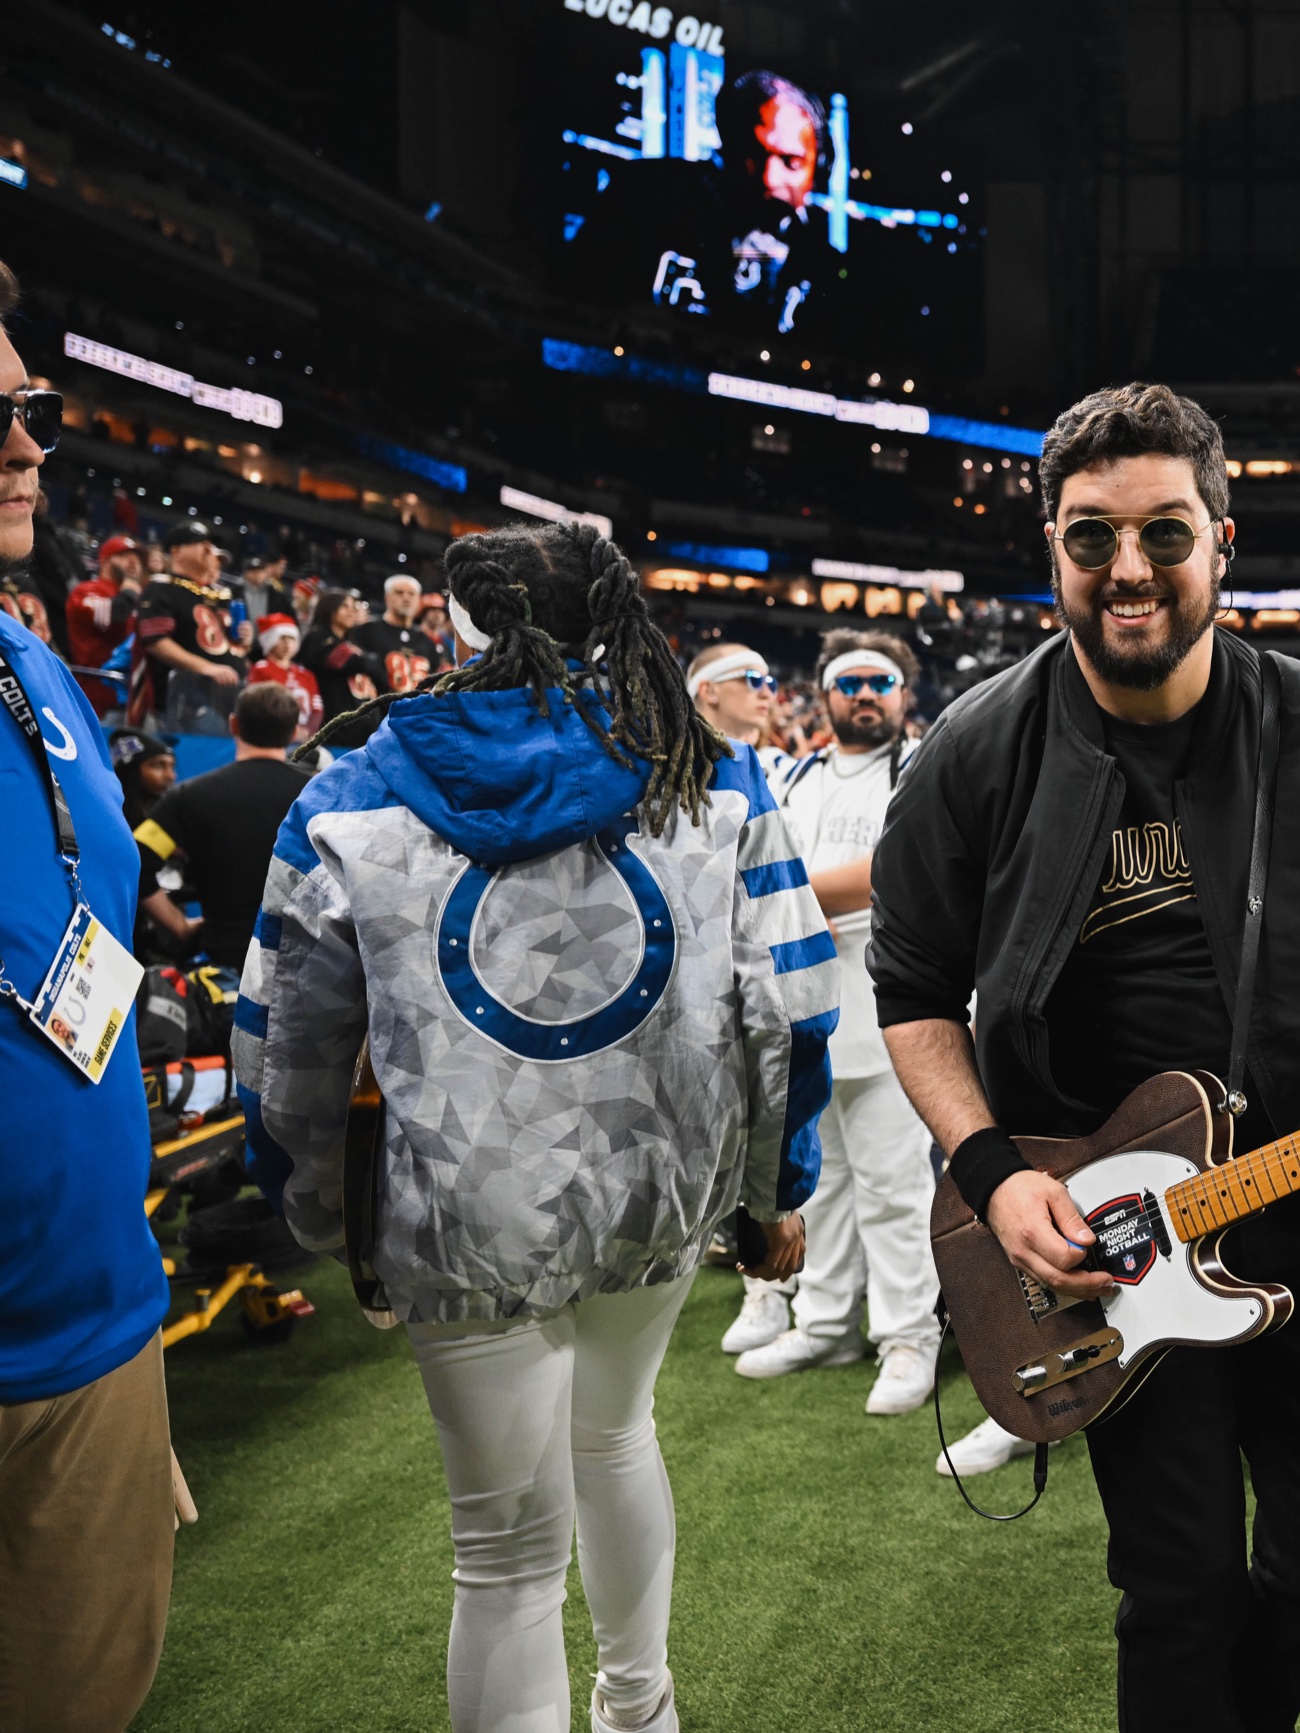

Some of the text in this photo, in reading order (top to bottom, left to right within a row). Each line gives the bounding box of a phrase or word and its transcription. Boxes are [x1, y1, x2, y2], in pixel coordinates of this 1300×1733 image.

[675, 15, 726, 58] OIL
[0, 676, 39, 737] COLTS
[48, 934, 82, 1003] INDIANAPOLIS COLTS
[94, 1020, 118, 1066] GAME SERVICES
[1099, 1218, 1139, 1242] MONDAY
[1104, 1209, 1127, 1225] ESPN
[1106, 1229, 1136, 1248] NIGHT
